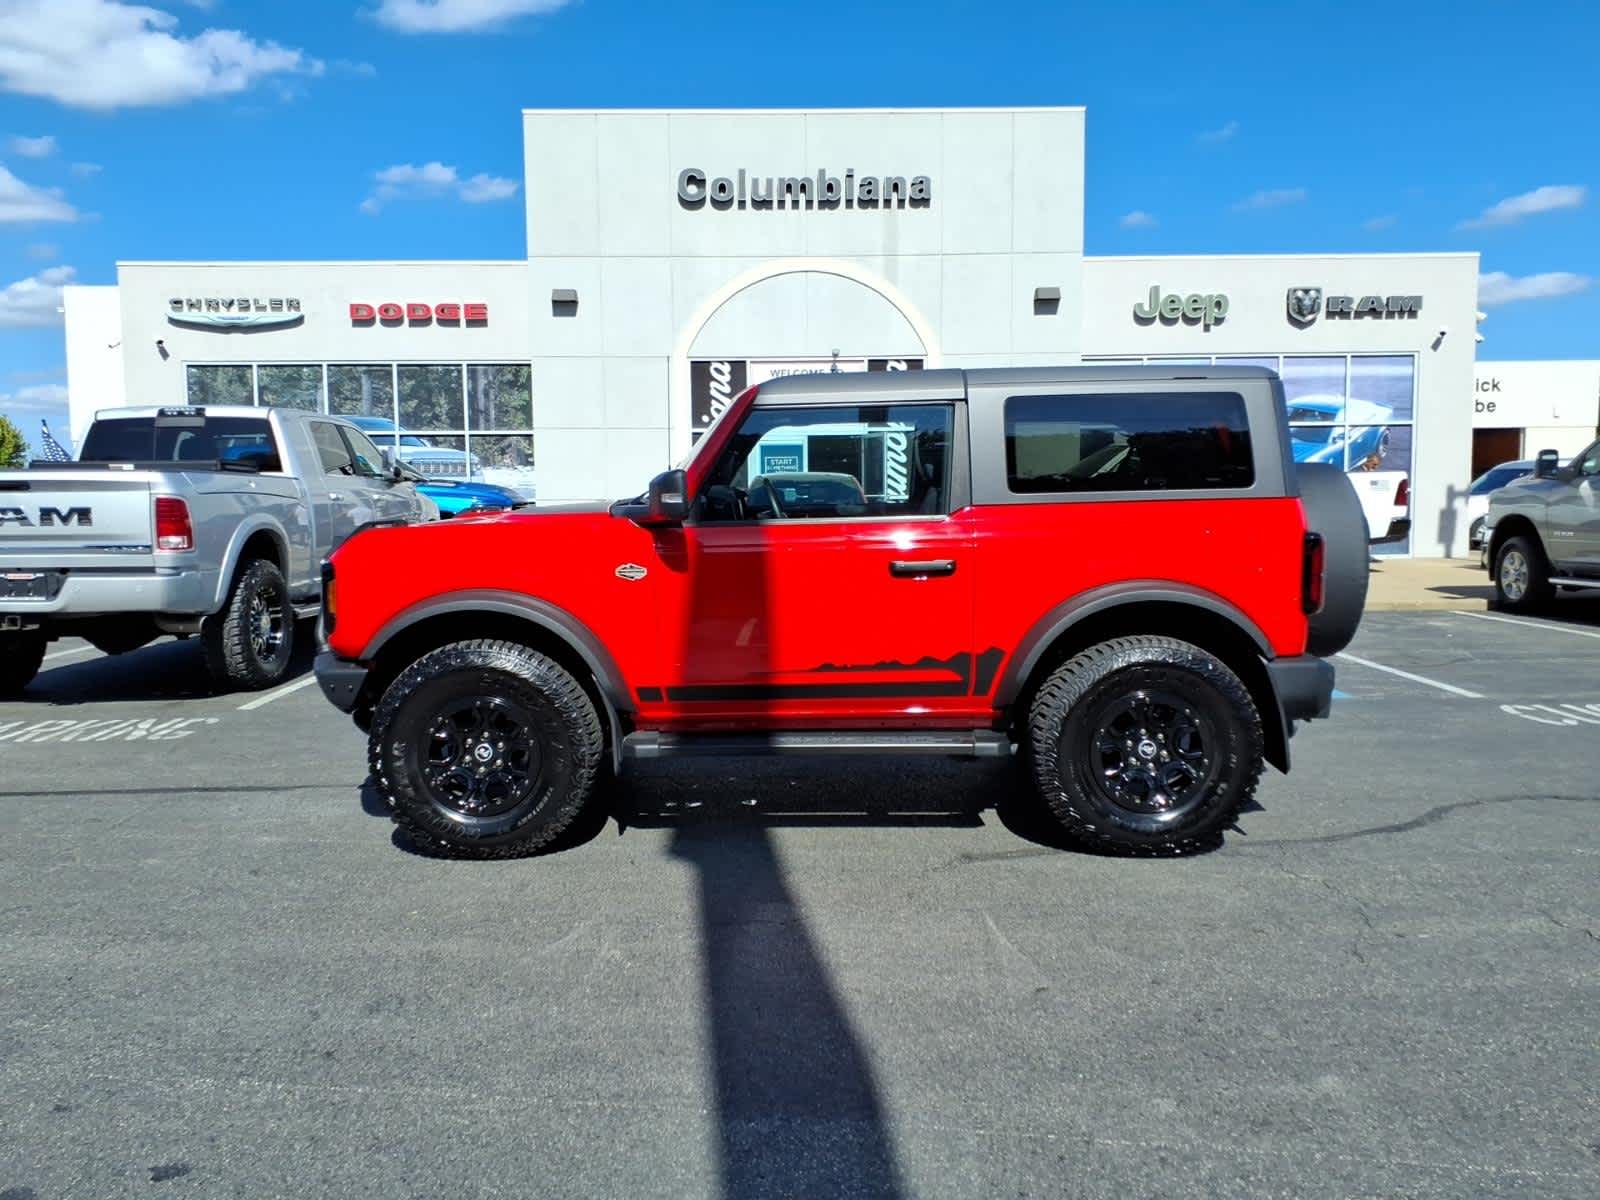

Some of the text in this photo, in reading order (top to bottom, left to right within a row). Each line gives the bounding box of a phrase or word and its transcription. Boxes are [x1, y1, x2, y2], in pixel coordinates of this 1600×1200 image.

[678, 168, 932, 206] Columbiana
[169, 298, 301, 311] CHRYSLER
[350, 303, 488, 324] DODGE
[1134, 284, 1229, 328] Jeep
[1326, 295, 1423, 315] RAM
